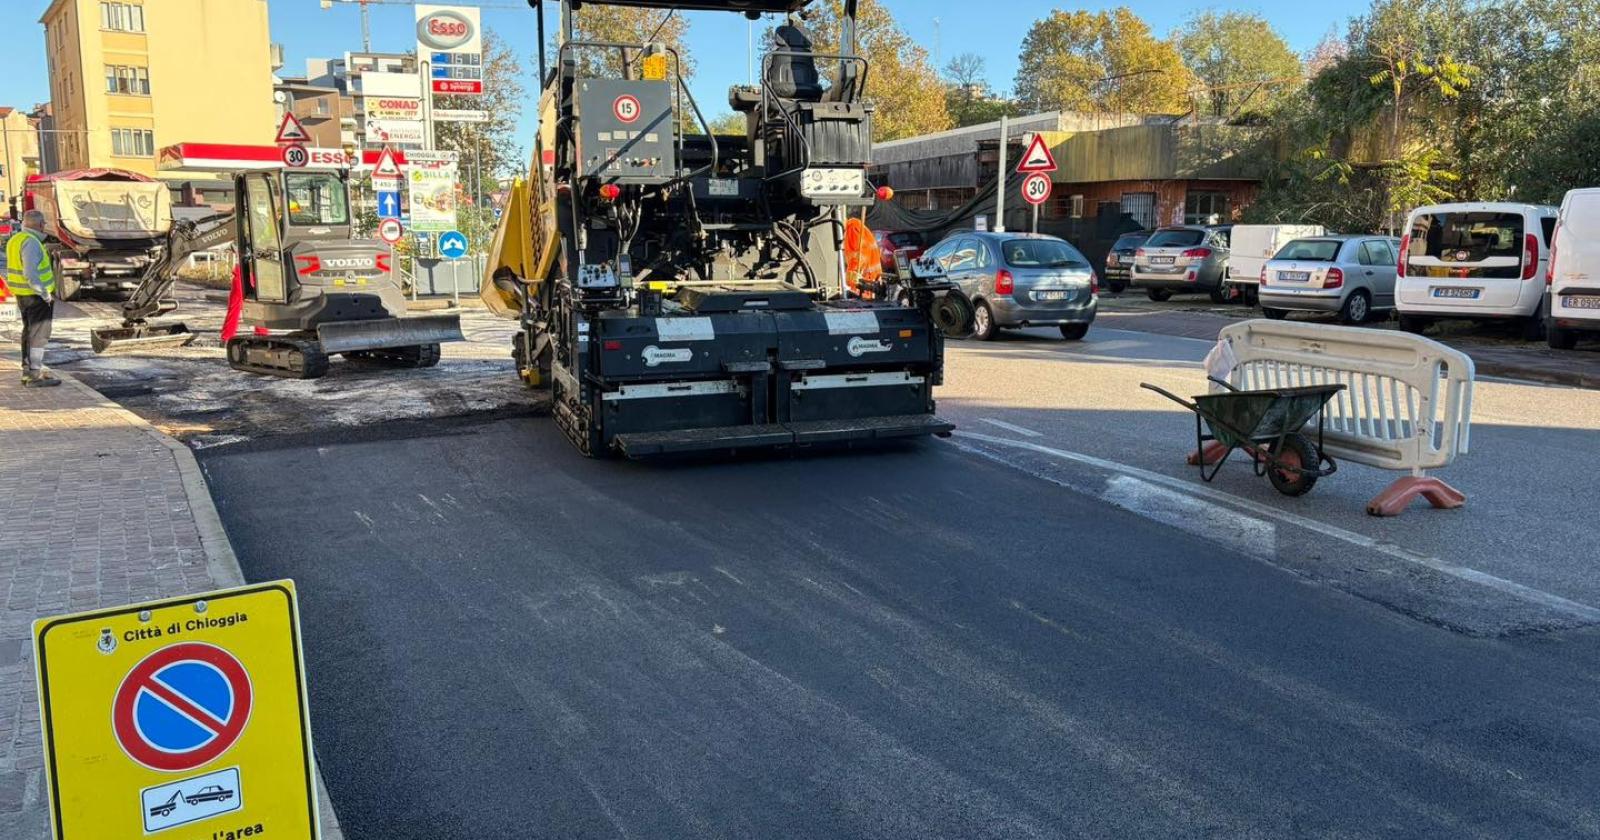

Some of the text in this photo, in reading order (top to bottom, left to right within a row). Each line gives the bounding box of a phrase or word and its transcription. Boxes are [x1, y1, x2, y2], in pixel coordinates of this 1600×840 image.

[430, 19, 466, 36] Esso
[379, 99, 419, 109] CONAD
[621, 103, 632, 114] 15
[288, 149, 303, 162] 30
[1030, 180, 1045, 195] 30
[202, 228, 228, 243] VOLVO
[323, 258, 373, 267] VOLVO
[123, 612, 248, 642] Città di Chioggia
[213, 823, 264, 840] l'area
